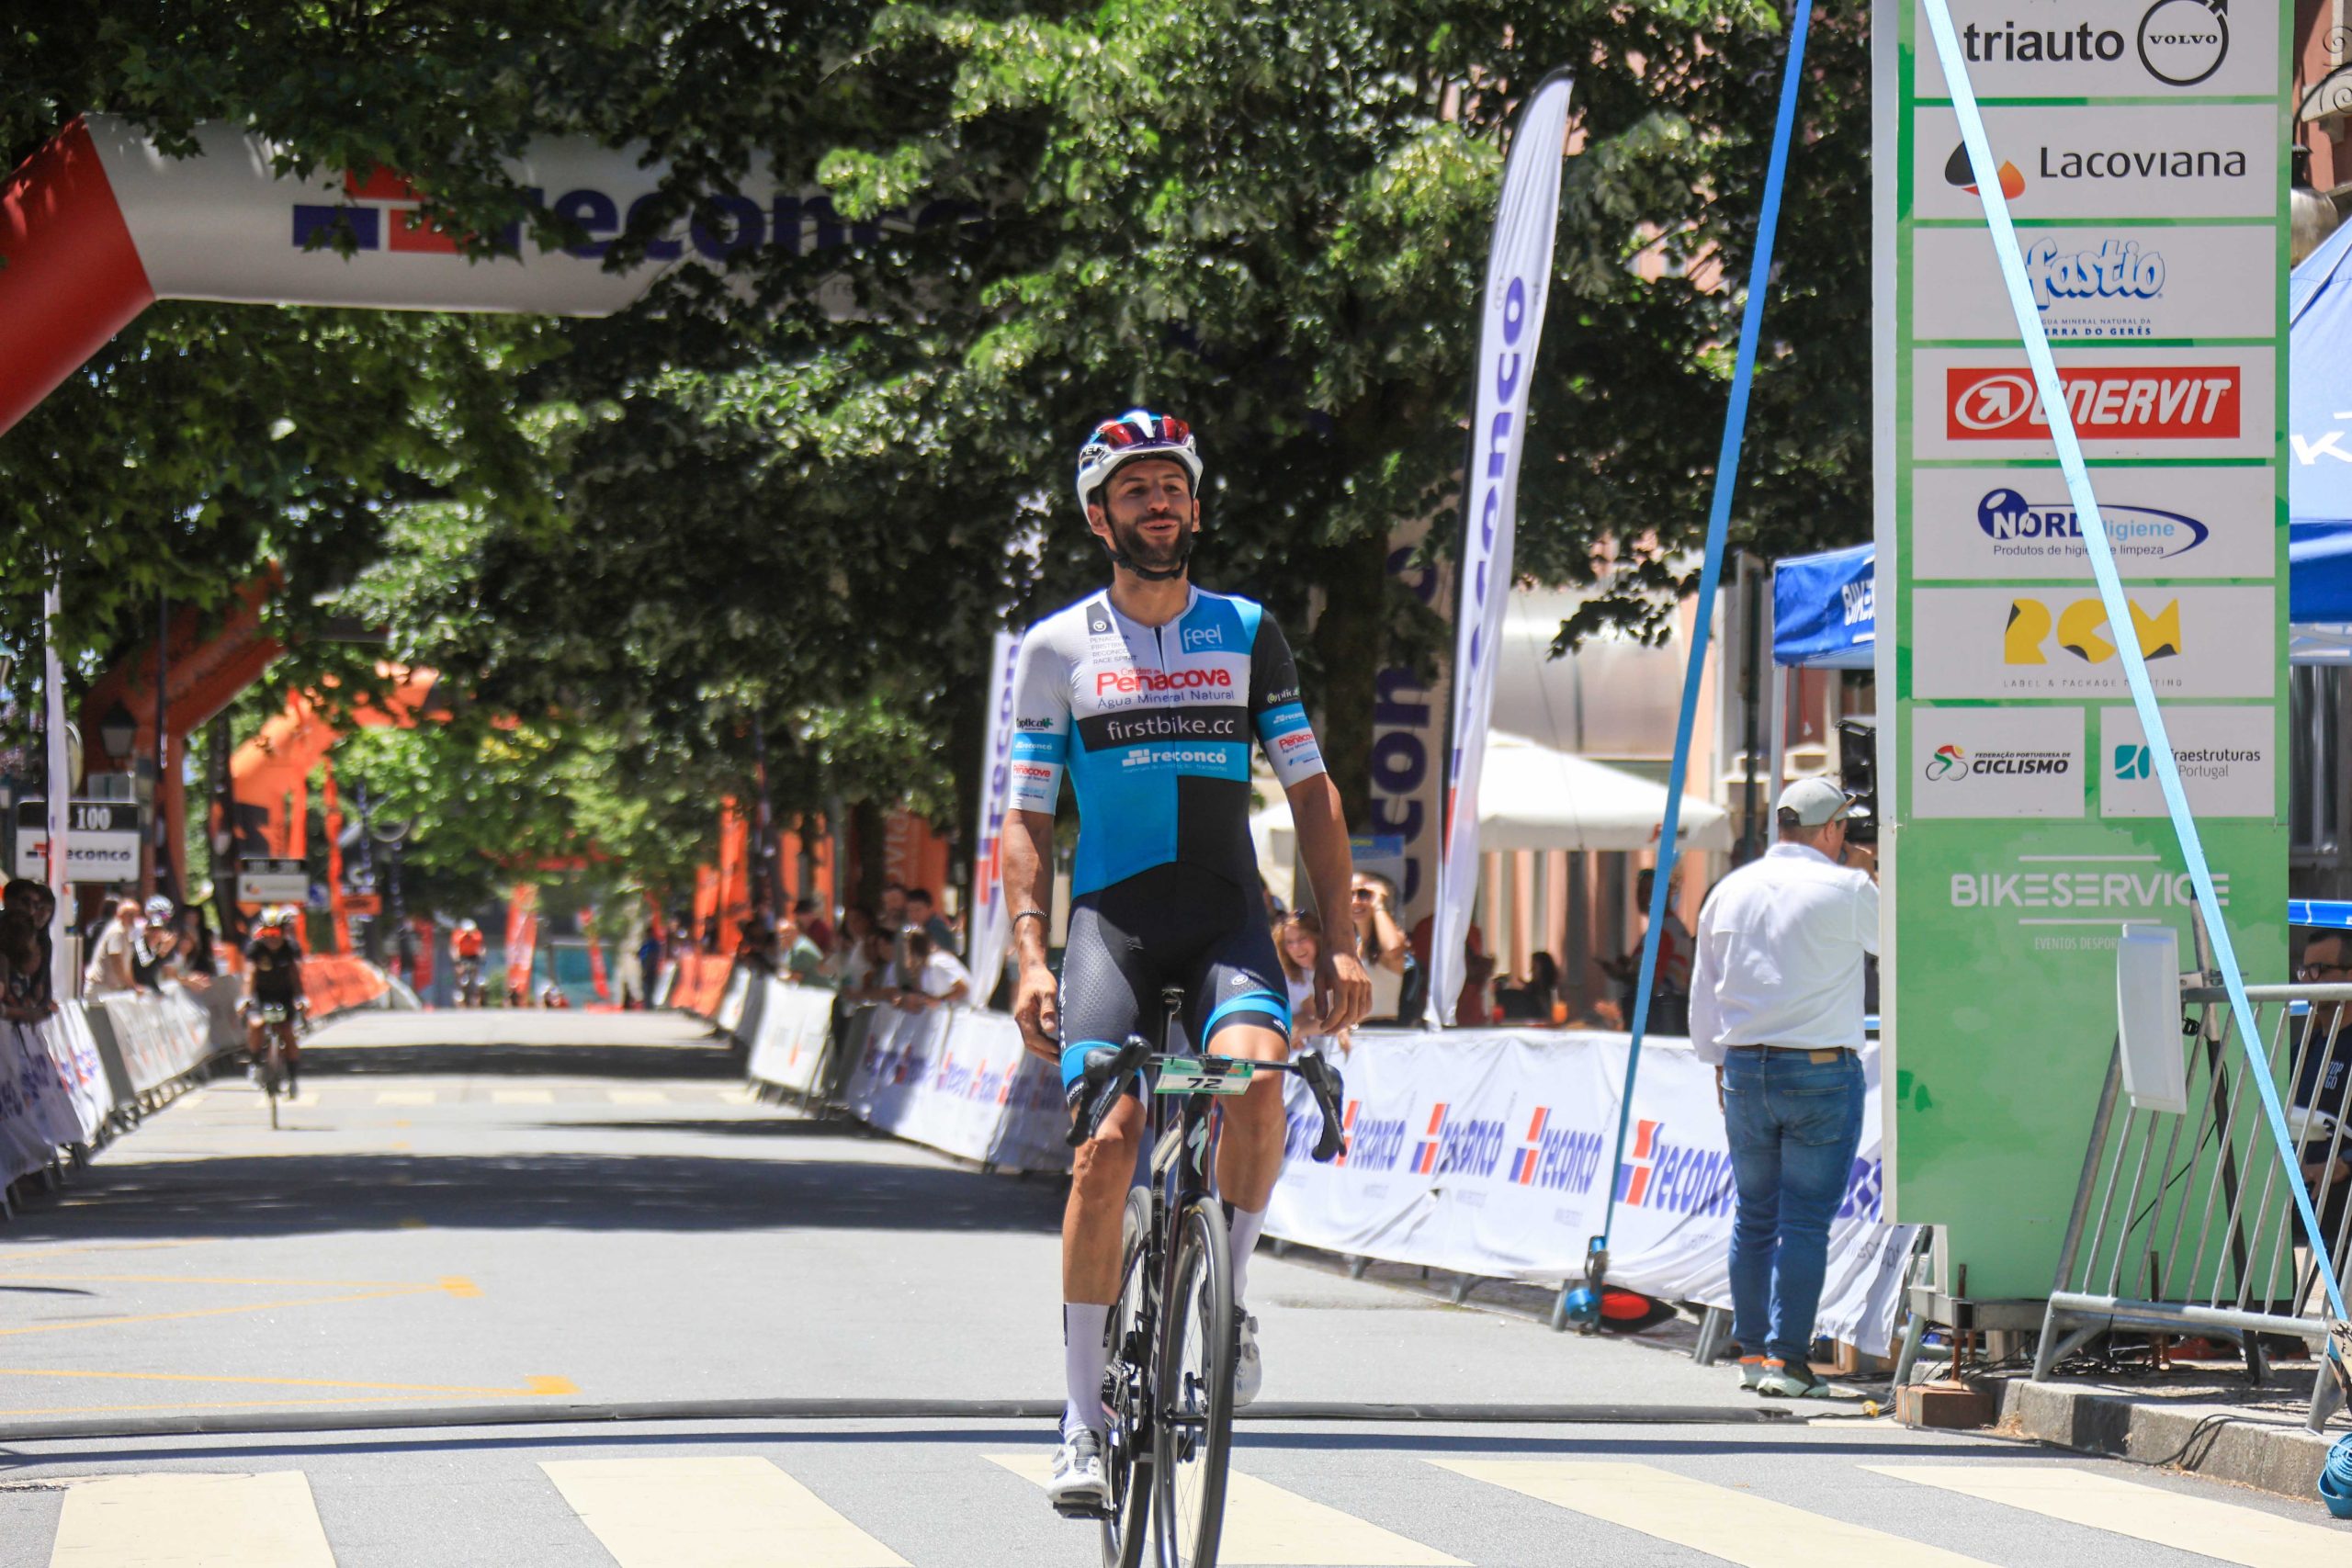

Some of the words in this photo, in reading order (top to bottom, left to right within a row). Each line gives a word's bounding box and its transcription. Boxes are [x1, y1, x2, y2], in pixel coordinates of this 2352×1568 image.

[1963, 21, 2125, 62] triauto
[2148, 34, 2218, 45] VOLVO
[2040, 147, 2247, 179] Lacoviana
[2026, 236, 2165, 310] fastio
[2043, 328, 2078, 336] ERRA
[2086, 328, 2104, 336] DO
[2109, 325, 2153, 336] GERÊS
[1994, 545, 2043, 555] Produtos
[2047, 545, 2062, 555] de
[2120, 545, 2164, 558] limpeza
[1183, 625, 1223, 651] feel
[1096, 669, 1232, 696] Penacova
[1137, 692, 1185, 705] Mineral
[1191, 690, 1235, 701] Natural
[1107, 716, 1235, 740] firstbike.cc
[1973, 760, 2069, 774] CICLISMO
[2178, 765, 2229, 780] Portugal
[76, 807, 112, 830] 100
[1951, 874, 2230, 907] BIKESERVICE
[2035, 937, 2076, 950] EVENTOS
[1187, 1077, 1223, 1089] 72
[1540, 1129, 1603, 1195] reconco
